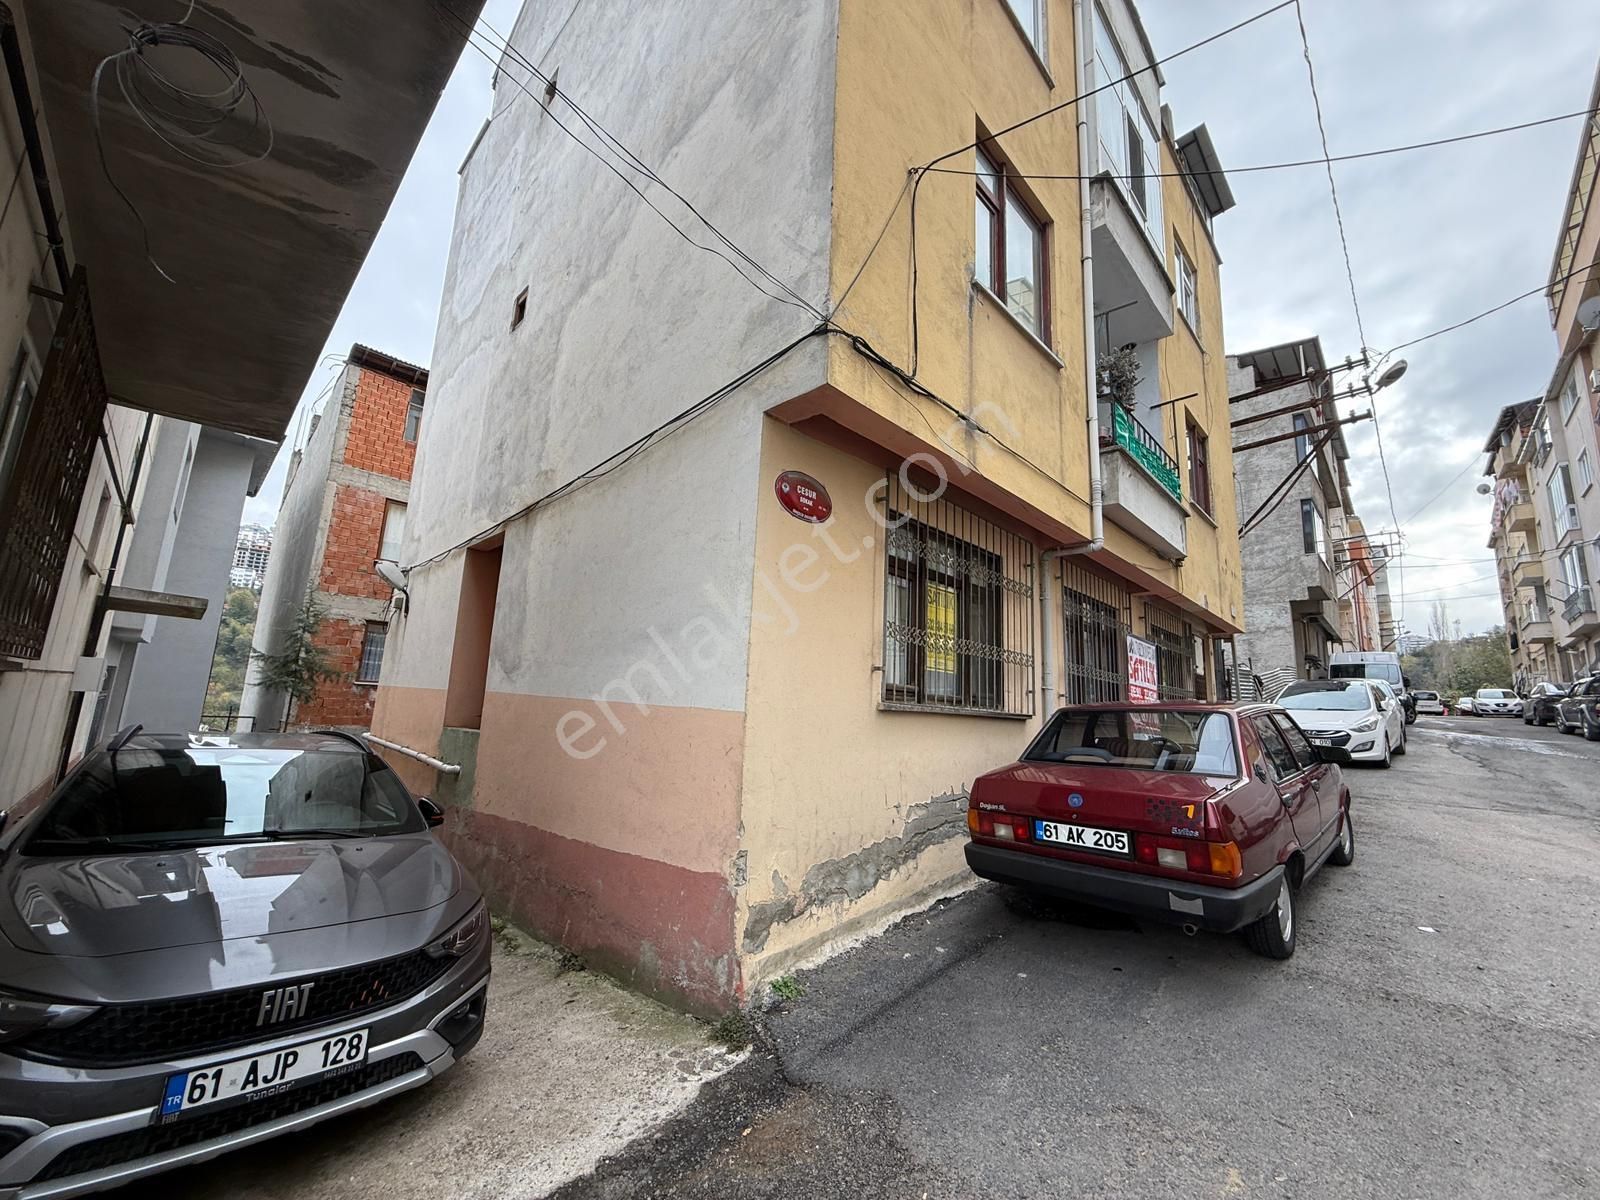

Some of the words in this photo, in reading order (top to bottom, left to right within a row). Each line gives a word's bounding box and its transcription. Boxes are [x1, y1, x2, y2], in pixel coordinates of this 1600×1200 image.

[797, 485, 817, 500] CESUR
[1043, 823, 1059, 840] 61
[1066, 827, 1086, 844] AK
[1092, 830, 1126, 851] 205
[256, 982, 315, 1027] FIAT
[167, 1095, 182, 1106] TR
[187, 1067, 224, 1104] 61
[240, 1050, 299, 1091] AJP
[321, 1033, 363, 1068] 128
